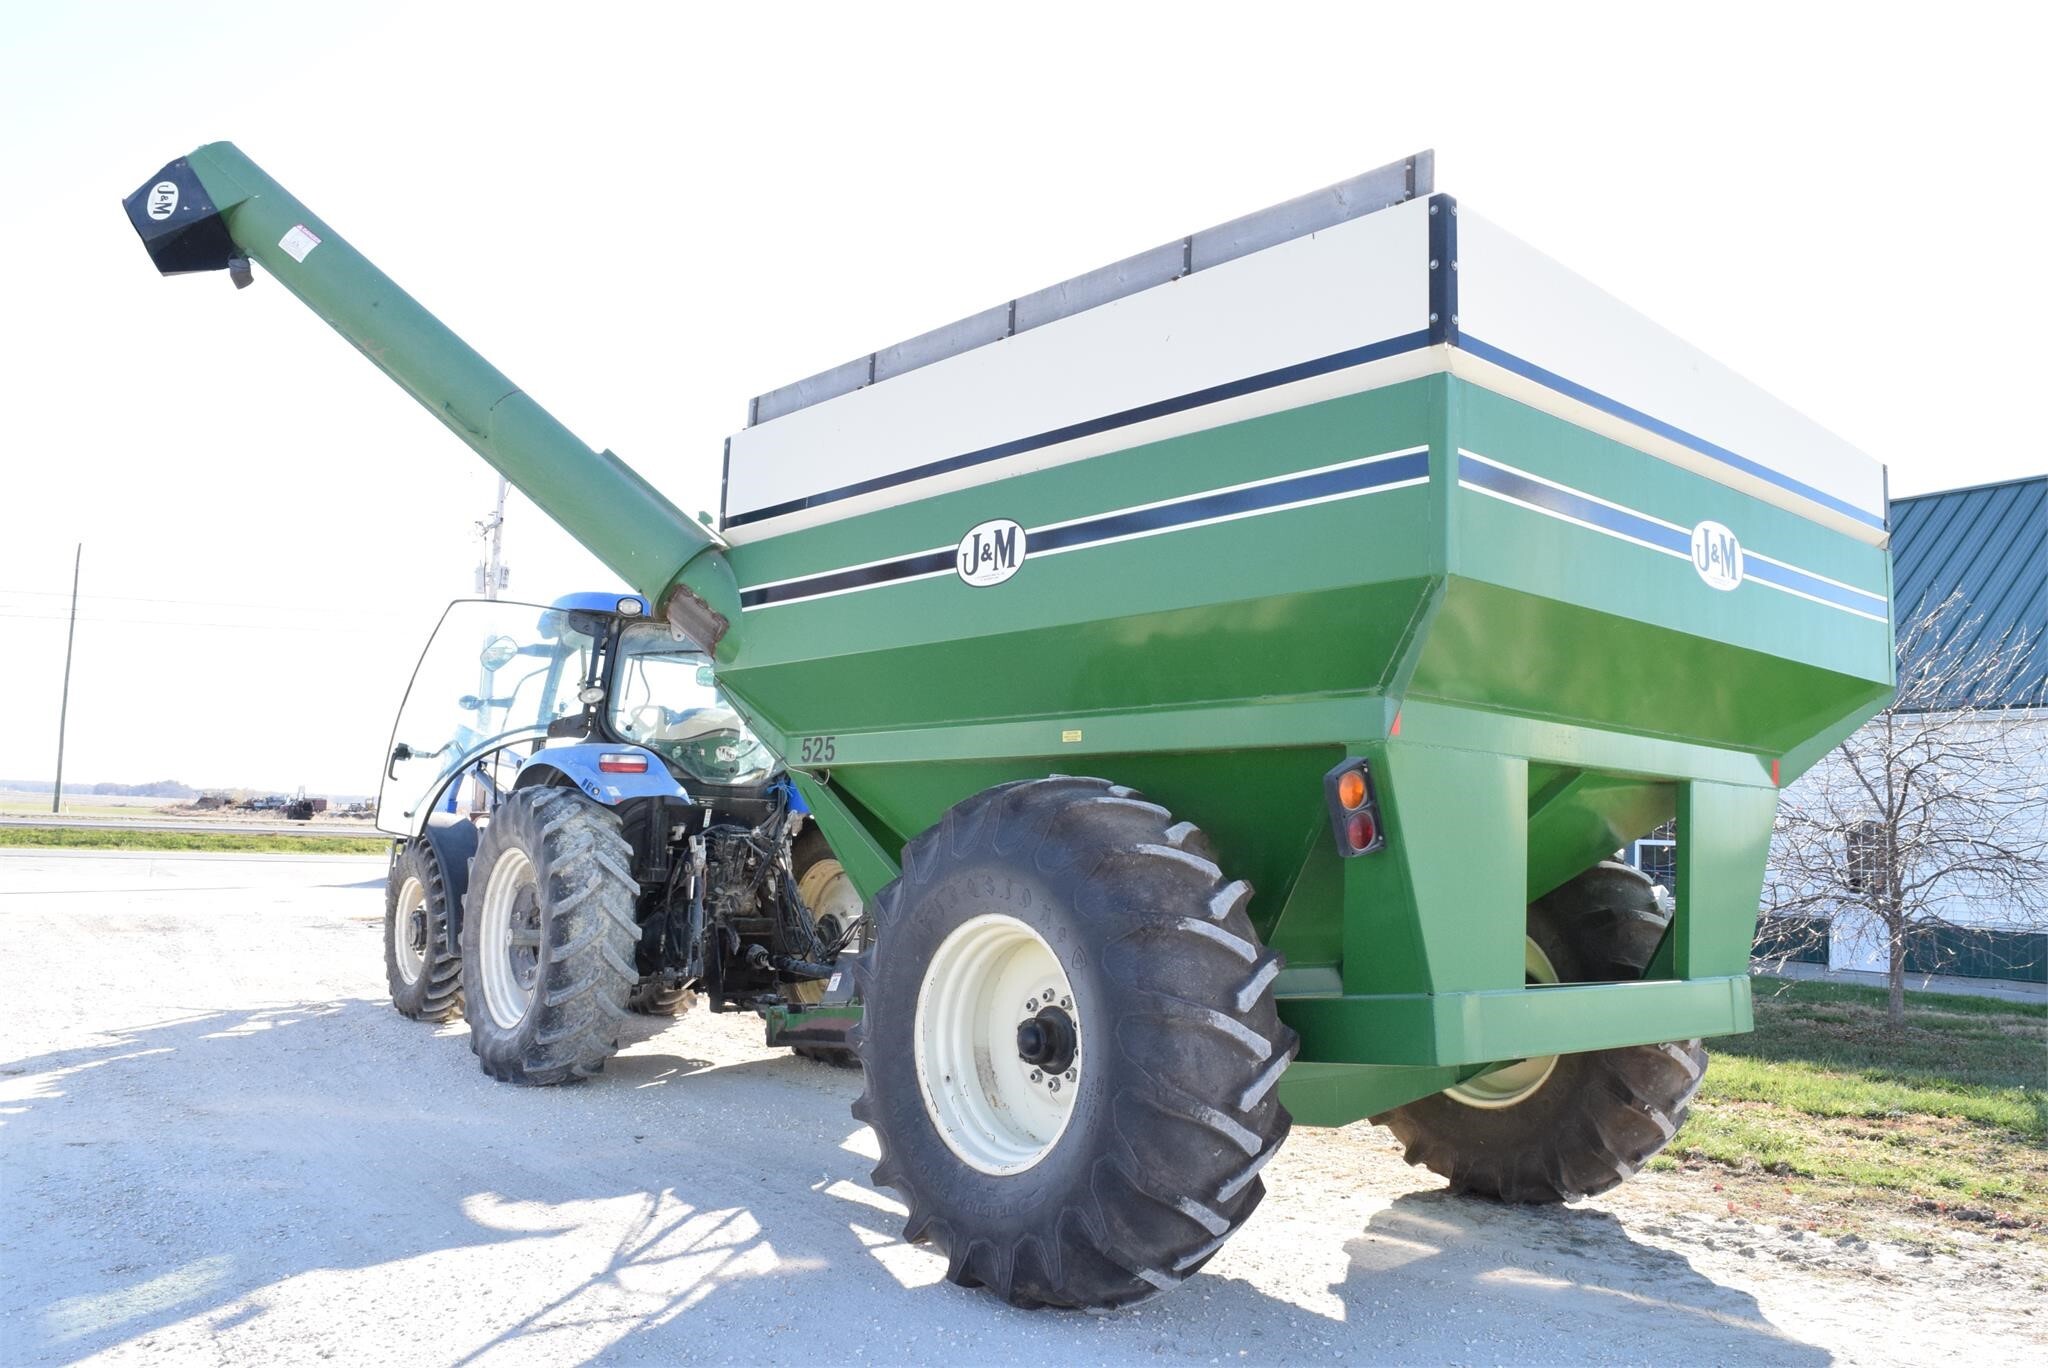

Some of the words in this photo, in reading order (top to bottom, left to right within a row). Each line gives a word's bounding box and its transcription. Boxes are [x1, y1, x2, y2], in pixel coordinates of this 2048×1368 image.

[153, 185, 175, 214] J&M
[962, 526, 1017, 576] J&M
[1696, 528, 1738, 580] J&M
[801, 736, 836, 763] 525
